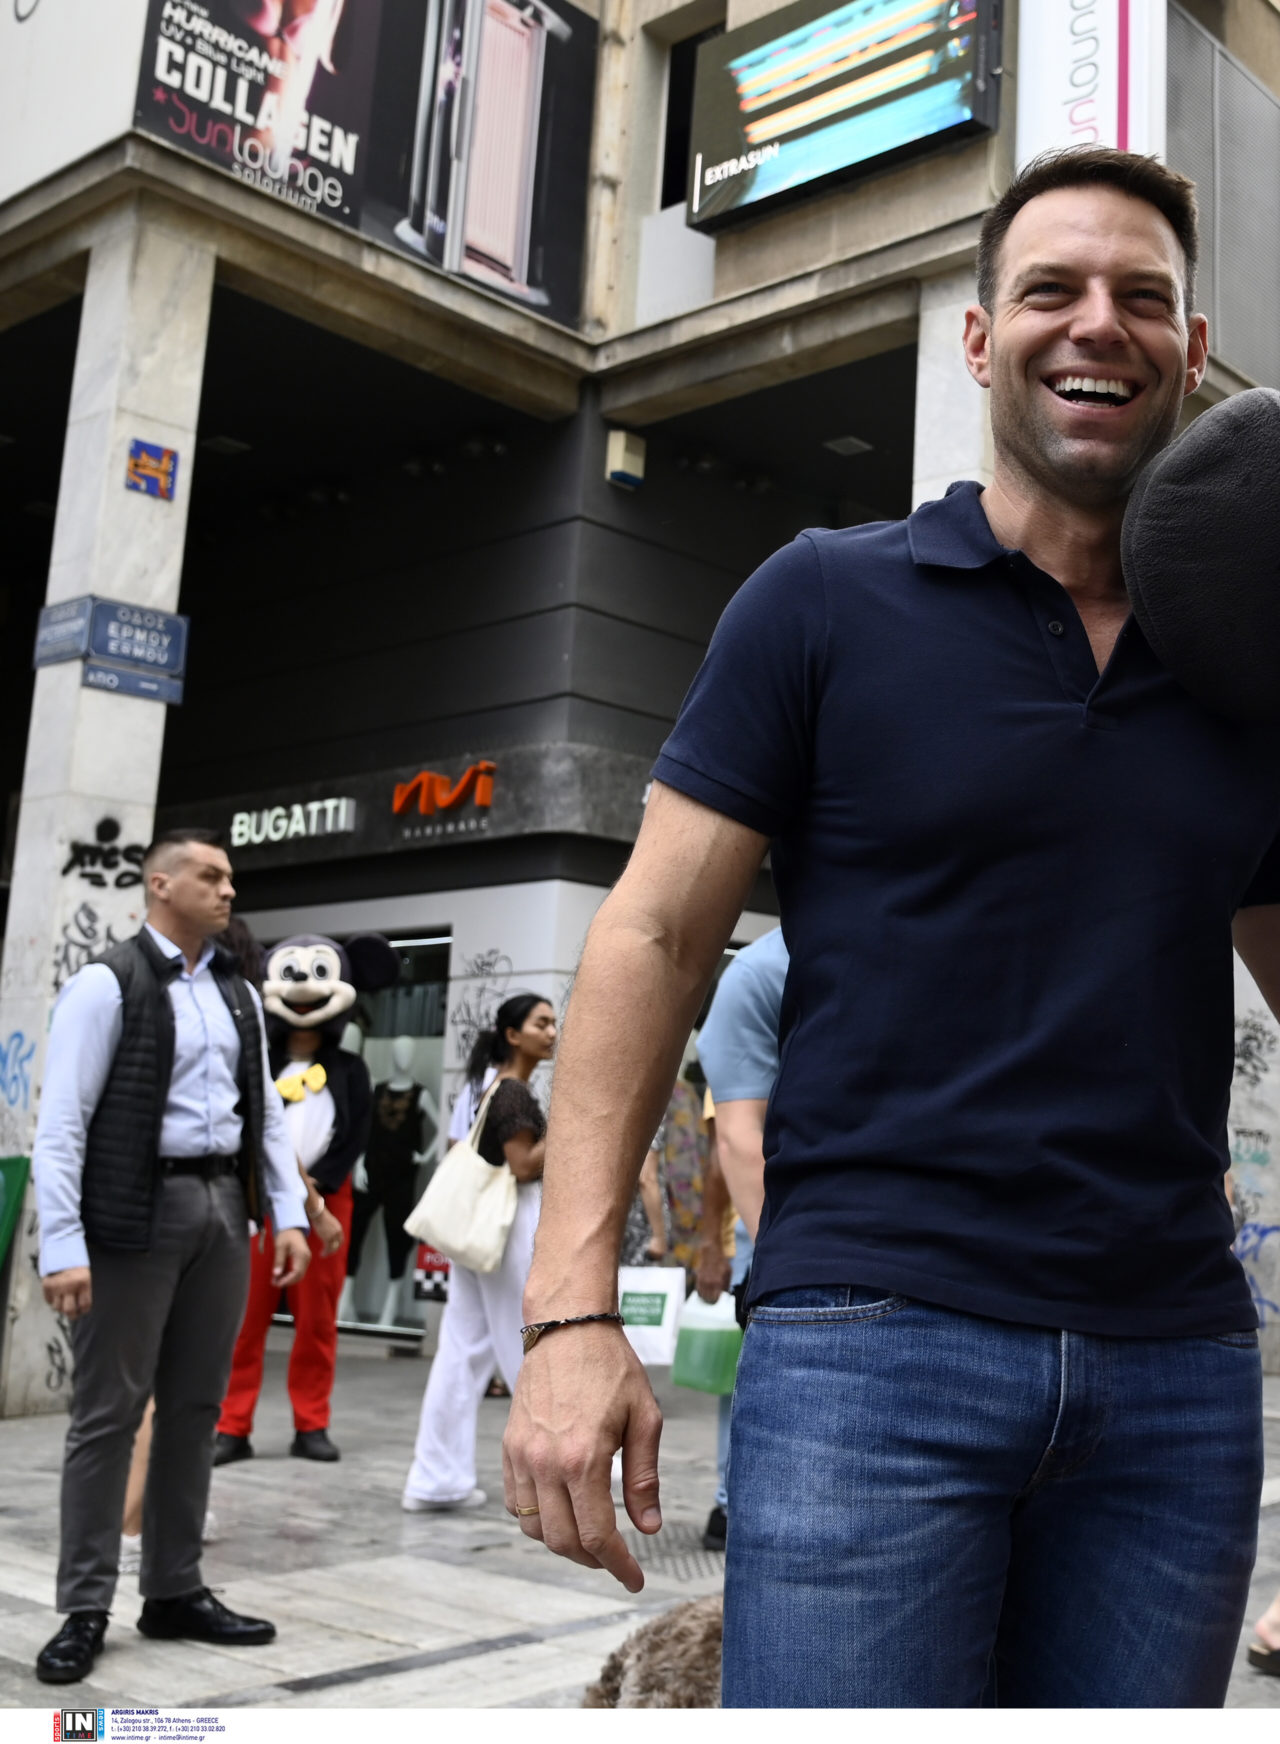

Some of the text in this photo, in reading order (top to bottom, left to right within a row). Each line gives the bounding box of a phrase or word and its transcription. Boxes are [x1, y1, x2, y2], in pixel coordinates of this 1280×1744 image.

[160, 20, 266, 86] UV Blue Light
[162, 1, 291, 79] HURRICANE
[231, 162, 318, 213] solarium
[704, 141, 779, 186] EXTRASUN
[231, 797, 356, 847] BUGATTI
